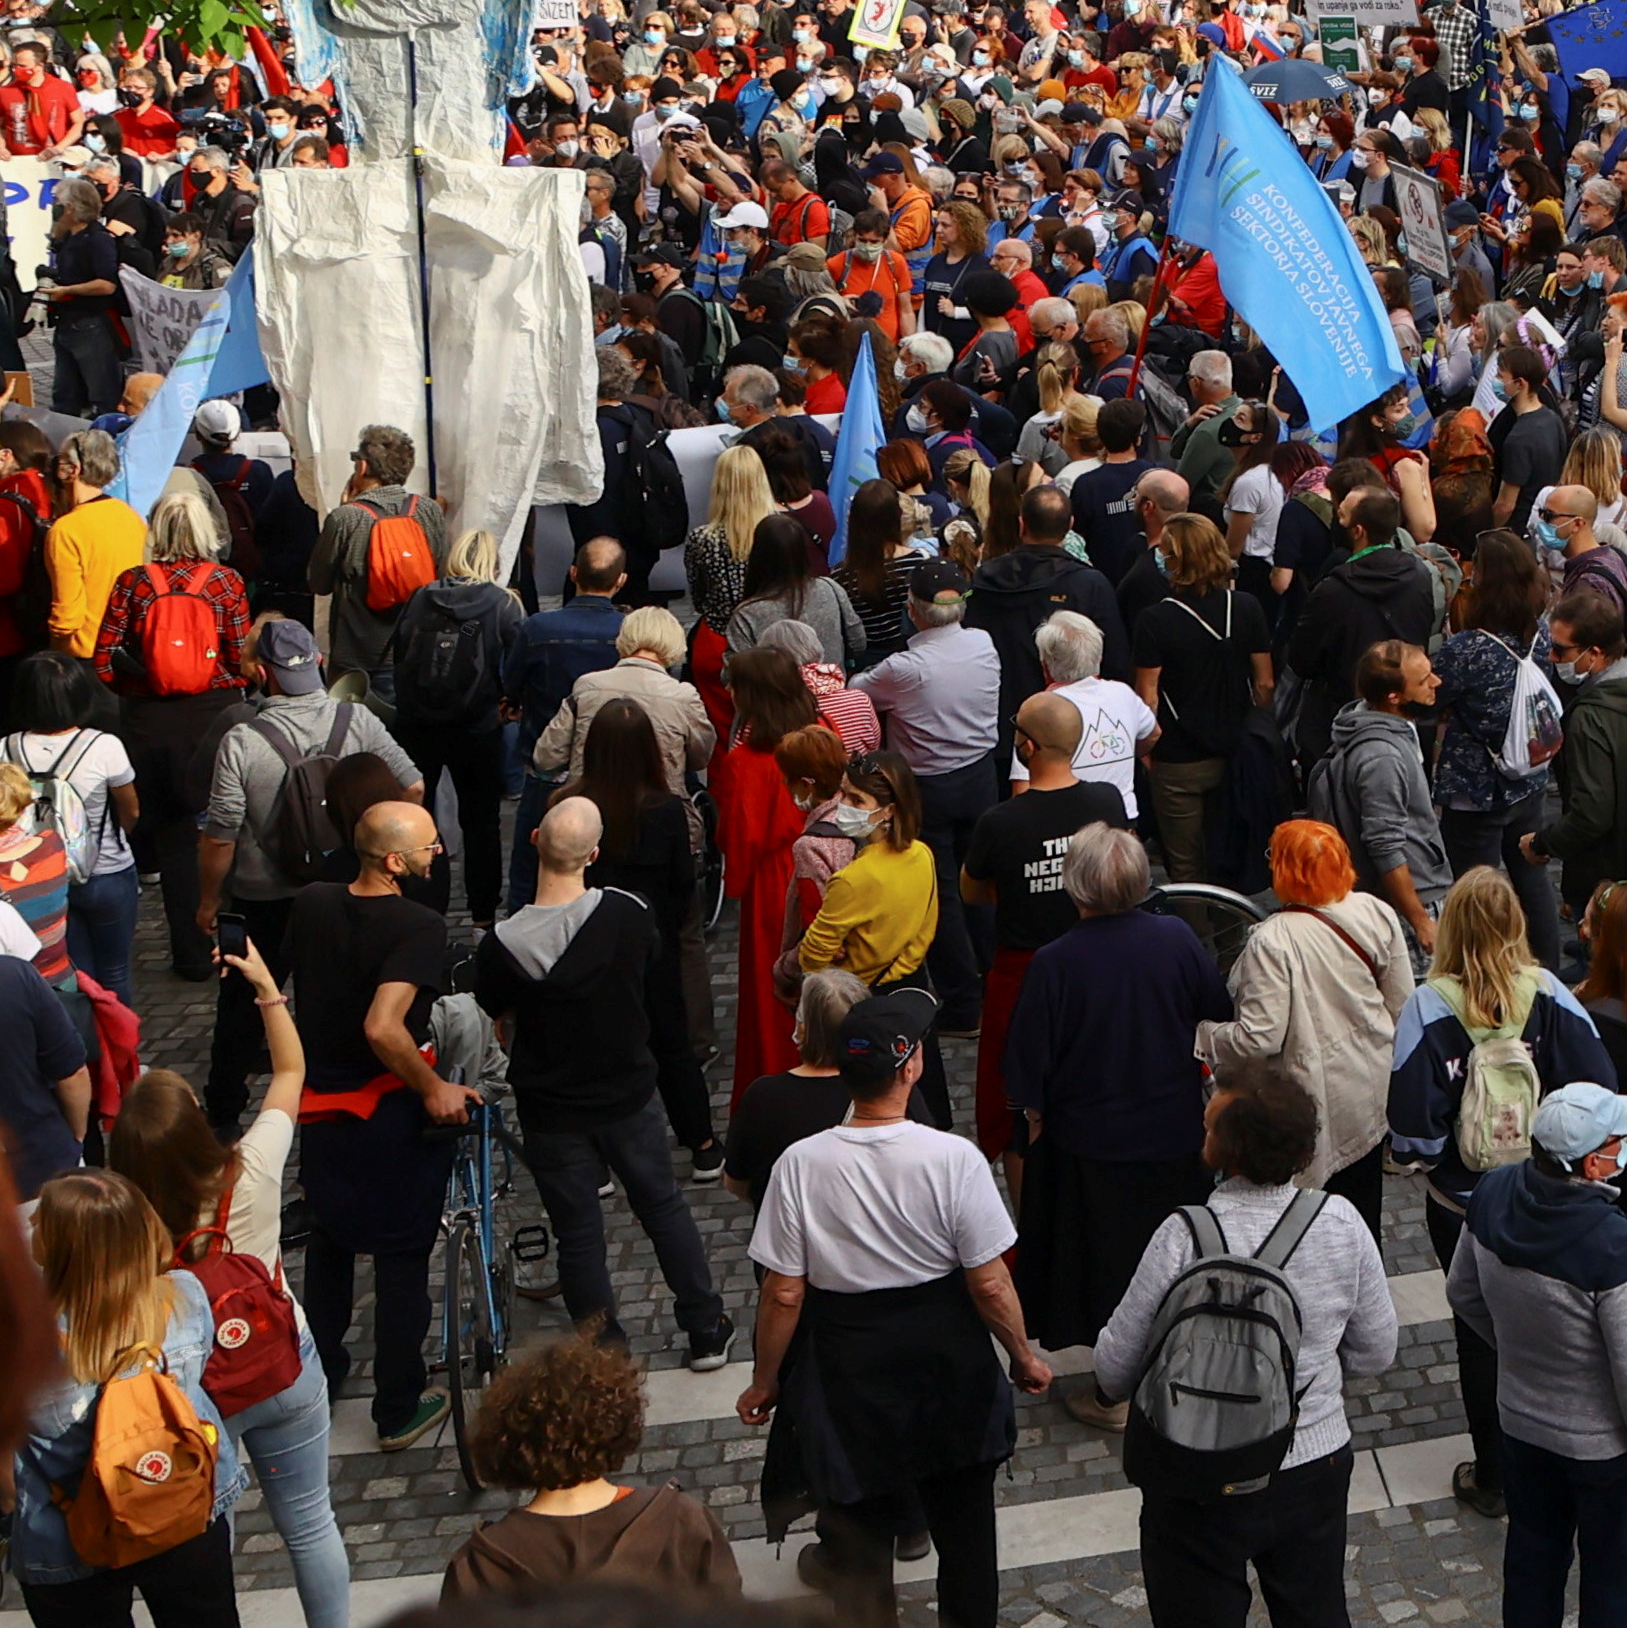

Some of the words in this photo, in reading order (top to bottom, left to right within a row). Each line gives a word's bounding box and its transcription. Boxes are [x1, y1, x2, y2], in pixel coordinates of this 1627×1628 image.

[1360, 1, 1374, 10] vodi
[1250, 86, 1278, 96] SVIZ
[1326, 76, 1347, 88] SVIZ
[1246, 193, 1331, 296] SINDIKATOV
[1324, 297, 1374, 380] JAVNEGA
[1261, 184, 1362, 323] KONFEDERACIJA
[1230, 205, 1300, 283] SEKTORJA
[1296, 281, 1360, 378] SLOVENIJE
